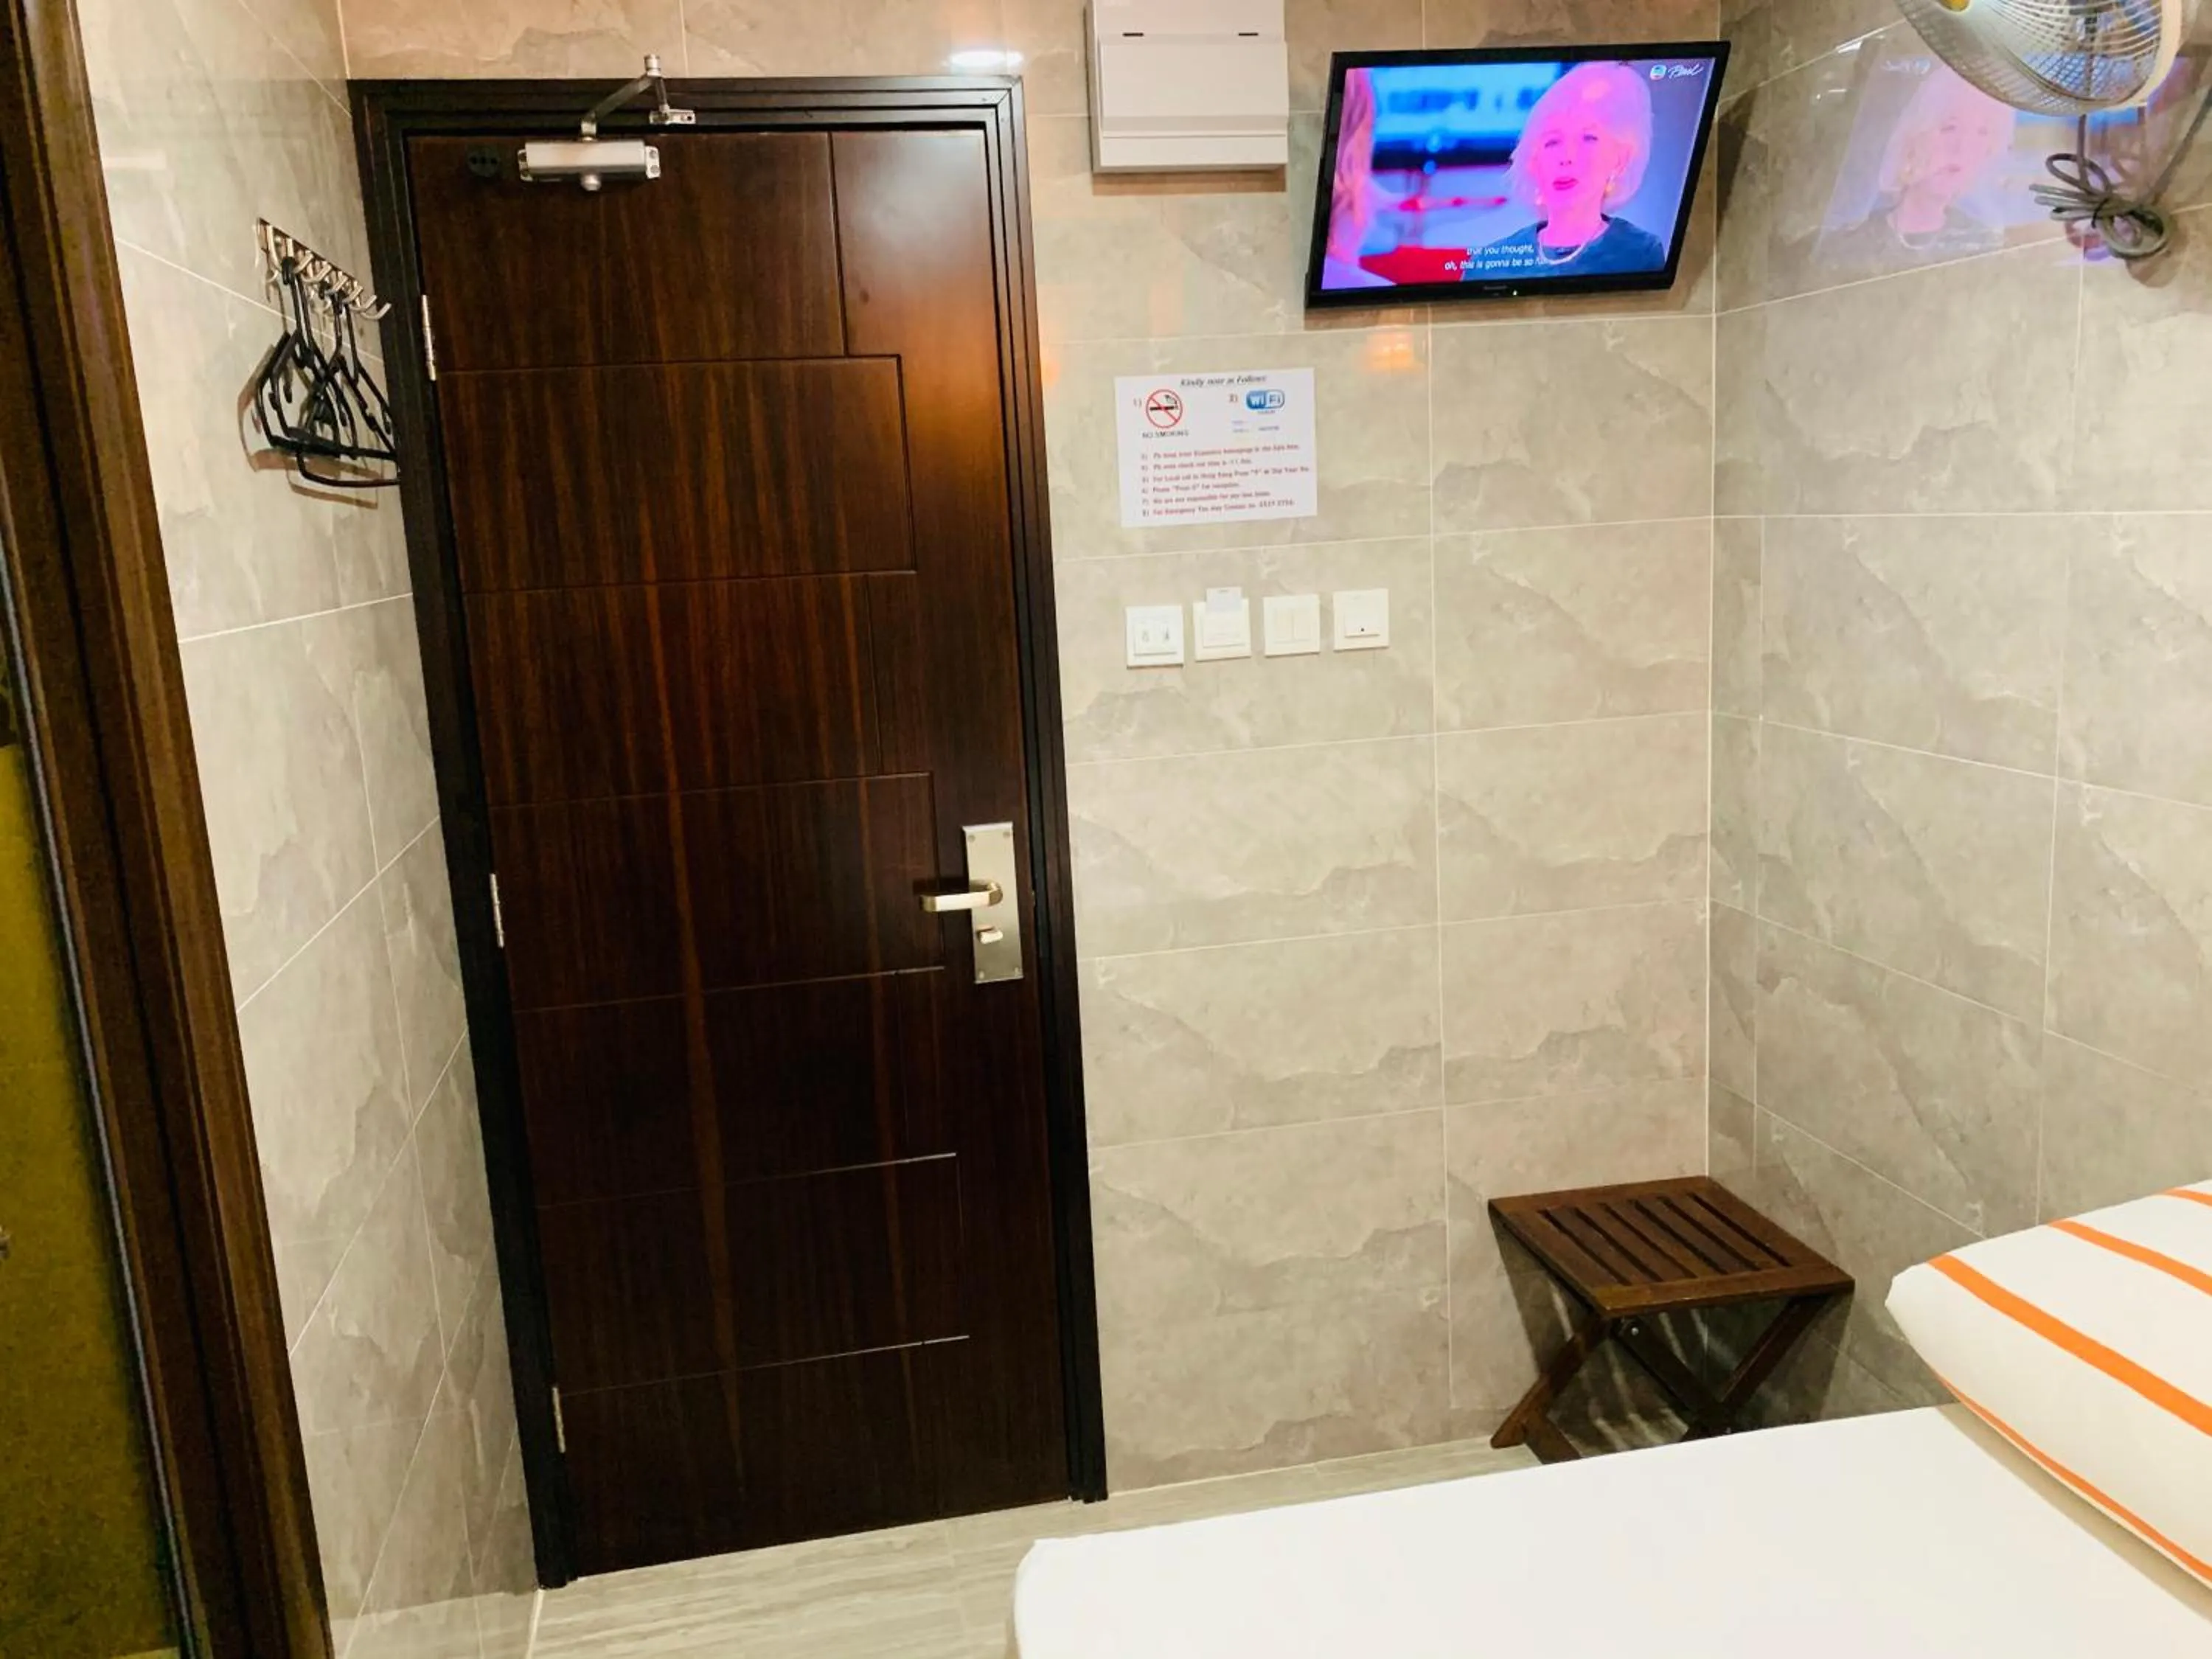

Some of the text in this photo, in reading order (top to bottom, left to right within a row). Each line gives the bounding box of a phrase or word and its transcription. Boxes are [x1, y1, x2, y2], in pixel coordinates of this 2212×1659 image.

[1484, 248, 1499, 257] you
[1485, 259, 1509, 270] gonna
[1512, 258, 1522, 266] be
[1155, 430, 1189, 438] SMOKING
